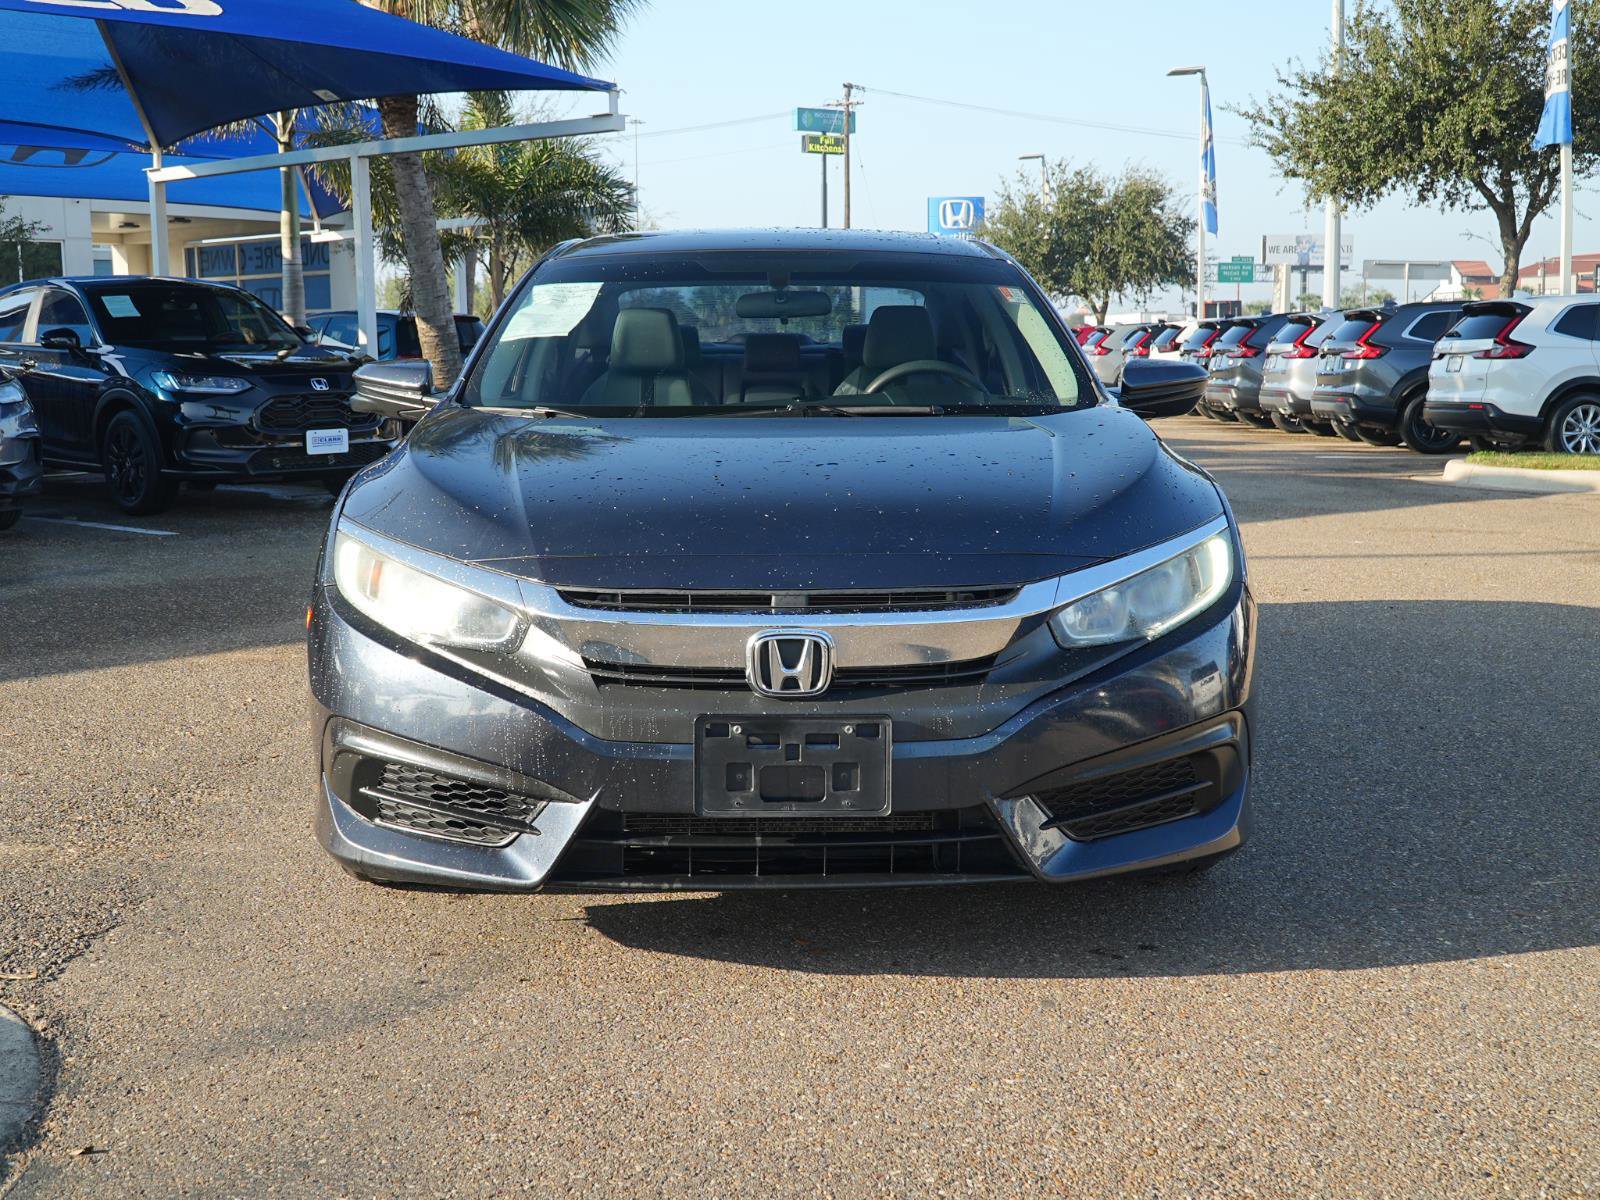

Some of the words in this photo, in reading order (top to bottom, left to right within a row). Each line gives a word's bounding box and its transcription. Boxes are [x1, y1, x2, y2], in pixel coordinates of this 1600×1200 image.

[820, 136, 834, 145] Full
[1268, 245, 1281, 254] WE
[1283, 245, 1298, 254] ARE
